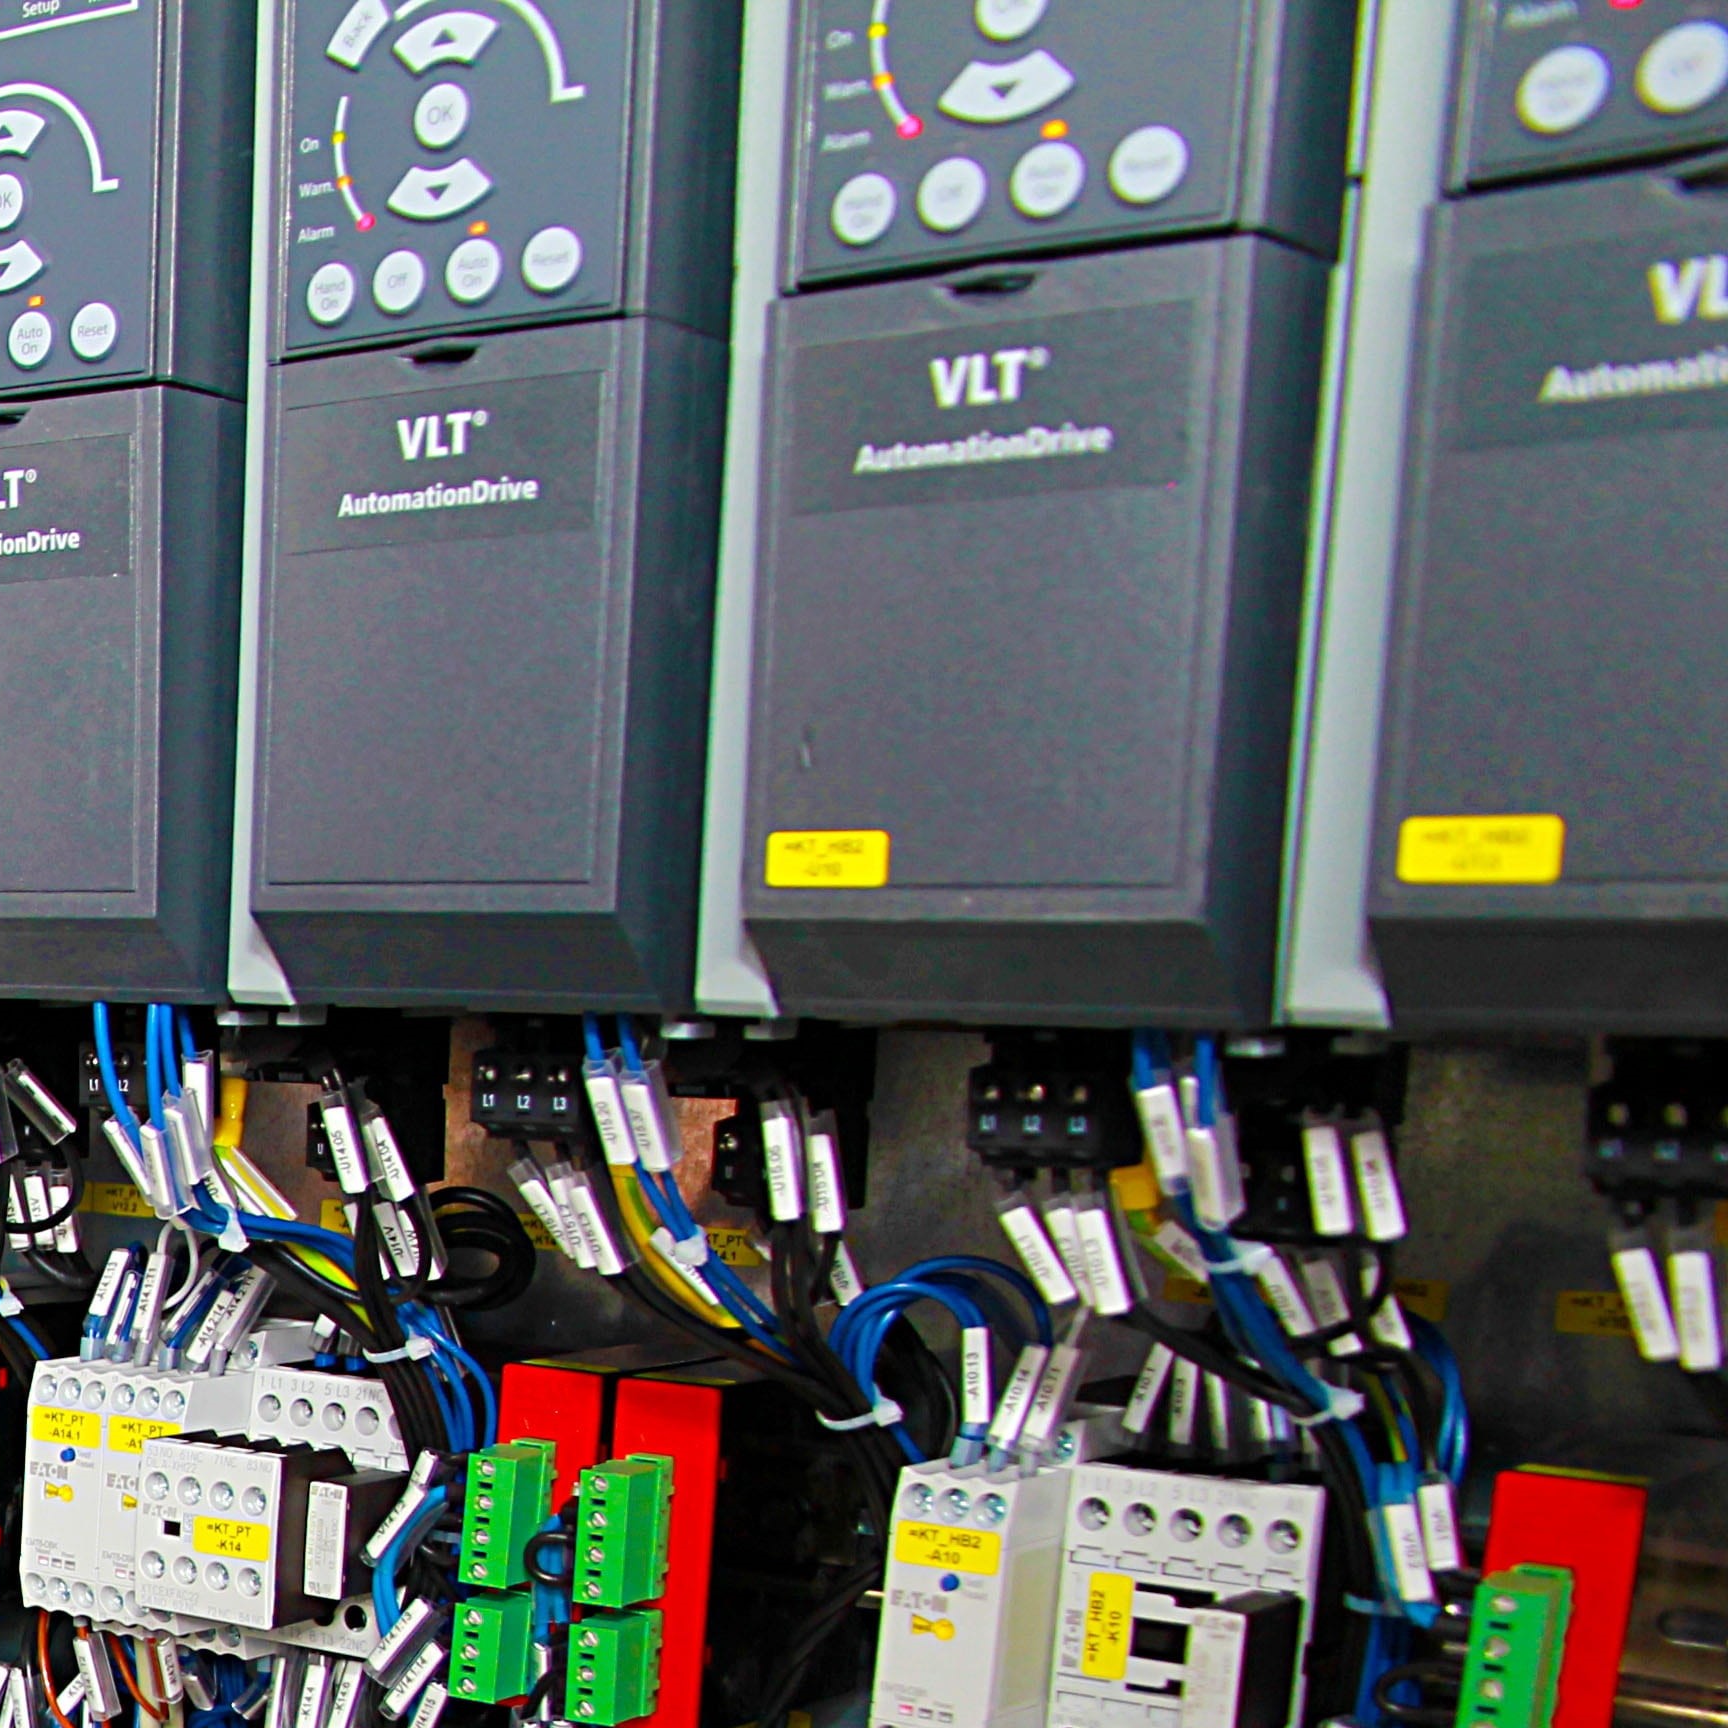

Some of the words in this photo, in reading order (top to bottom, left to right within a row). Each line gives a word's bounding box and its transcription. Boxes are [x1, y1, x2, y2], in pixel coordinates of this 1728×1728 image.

[426, 104, 455, 124] OK
[298, 225, 335, 243] Alarm
[1647, 253, 1728, 325] VL
[16, 326, 44, 341] Auto
[76, 322, 108, 338] Reset
[20, 341, 38, 355] On
[852, 420, 1113, 475] AutomationDrive
[337, 474, 539, 519] AutomationDrive
[89, 1079, 99, 1092] L1
[118, 1079, 129, 1093] L2
[482, 1093, 495, 1107] L1
[517, 1095, 531, 1110] L2
[553, 1096, 567, 1111] L3
[42, 1411, 86, 1428] =KT_PT
[48, 1427, 81, 1441] -A14.1
[120, 1420, 164, 1438] =KT_PT
[207, 1523, 252, 1539] =KT_PT
[908, 1528, 982, 1550] =KT_HB2
[216, 1539, 242, 1552] -K14
[925, 1547, 961, 1565] -A10
